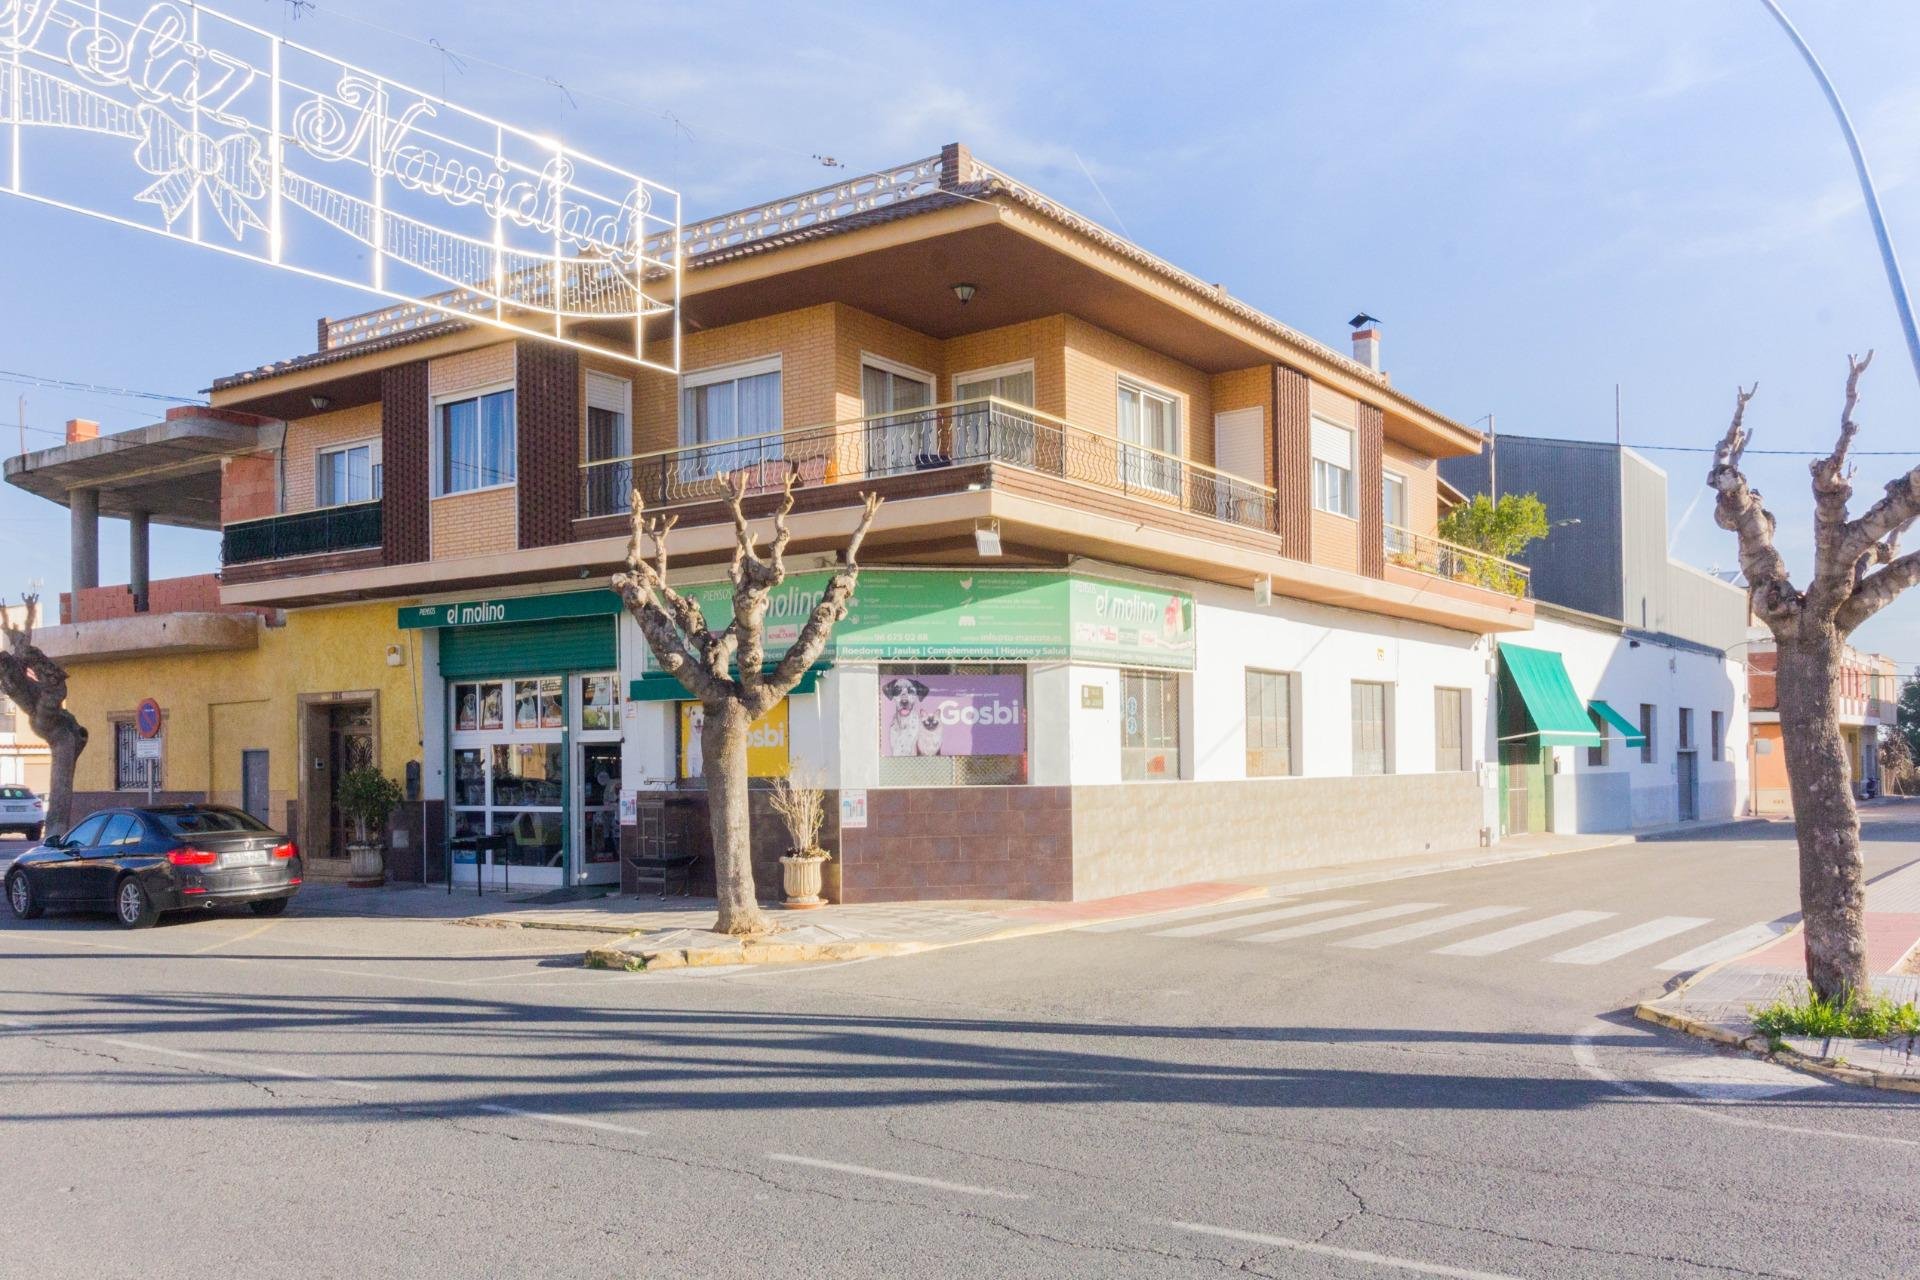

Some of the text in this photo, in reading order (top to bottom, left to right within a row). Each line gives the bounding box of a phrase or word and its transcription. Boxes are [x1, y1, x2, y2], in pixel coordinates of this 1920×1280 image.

[293, 78, 652, 264] Navidad
[447, 602, 505, 624] el molino
[1096, 589, 1156, 624] el molino
[842, 646, 884, 655] Roedores
[892, 646, 920, 655] Jaulas
[927, 646, 993, 656] Complementos
[1000, 646, 1034, 656] Higiene
[1034, 648, 1041, 656] y
[1042, 646, 1067, 655] Salud
[938, 699, 1019, 725] Gosbi
